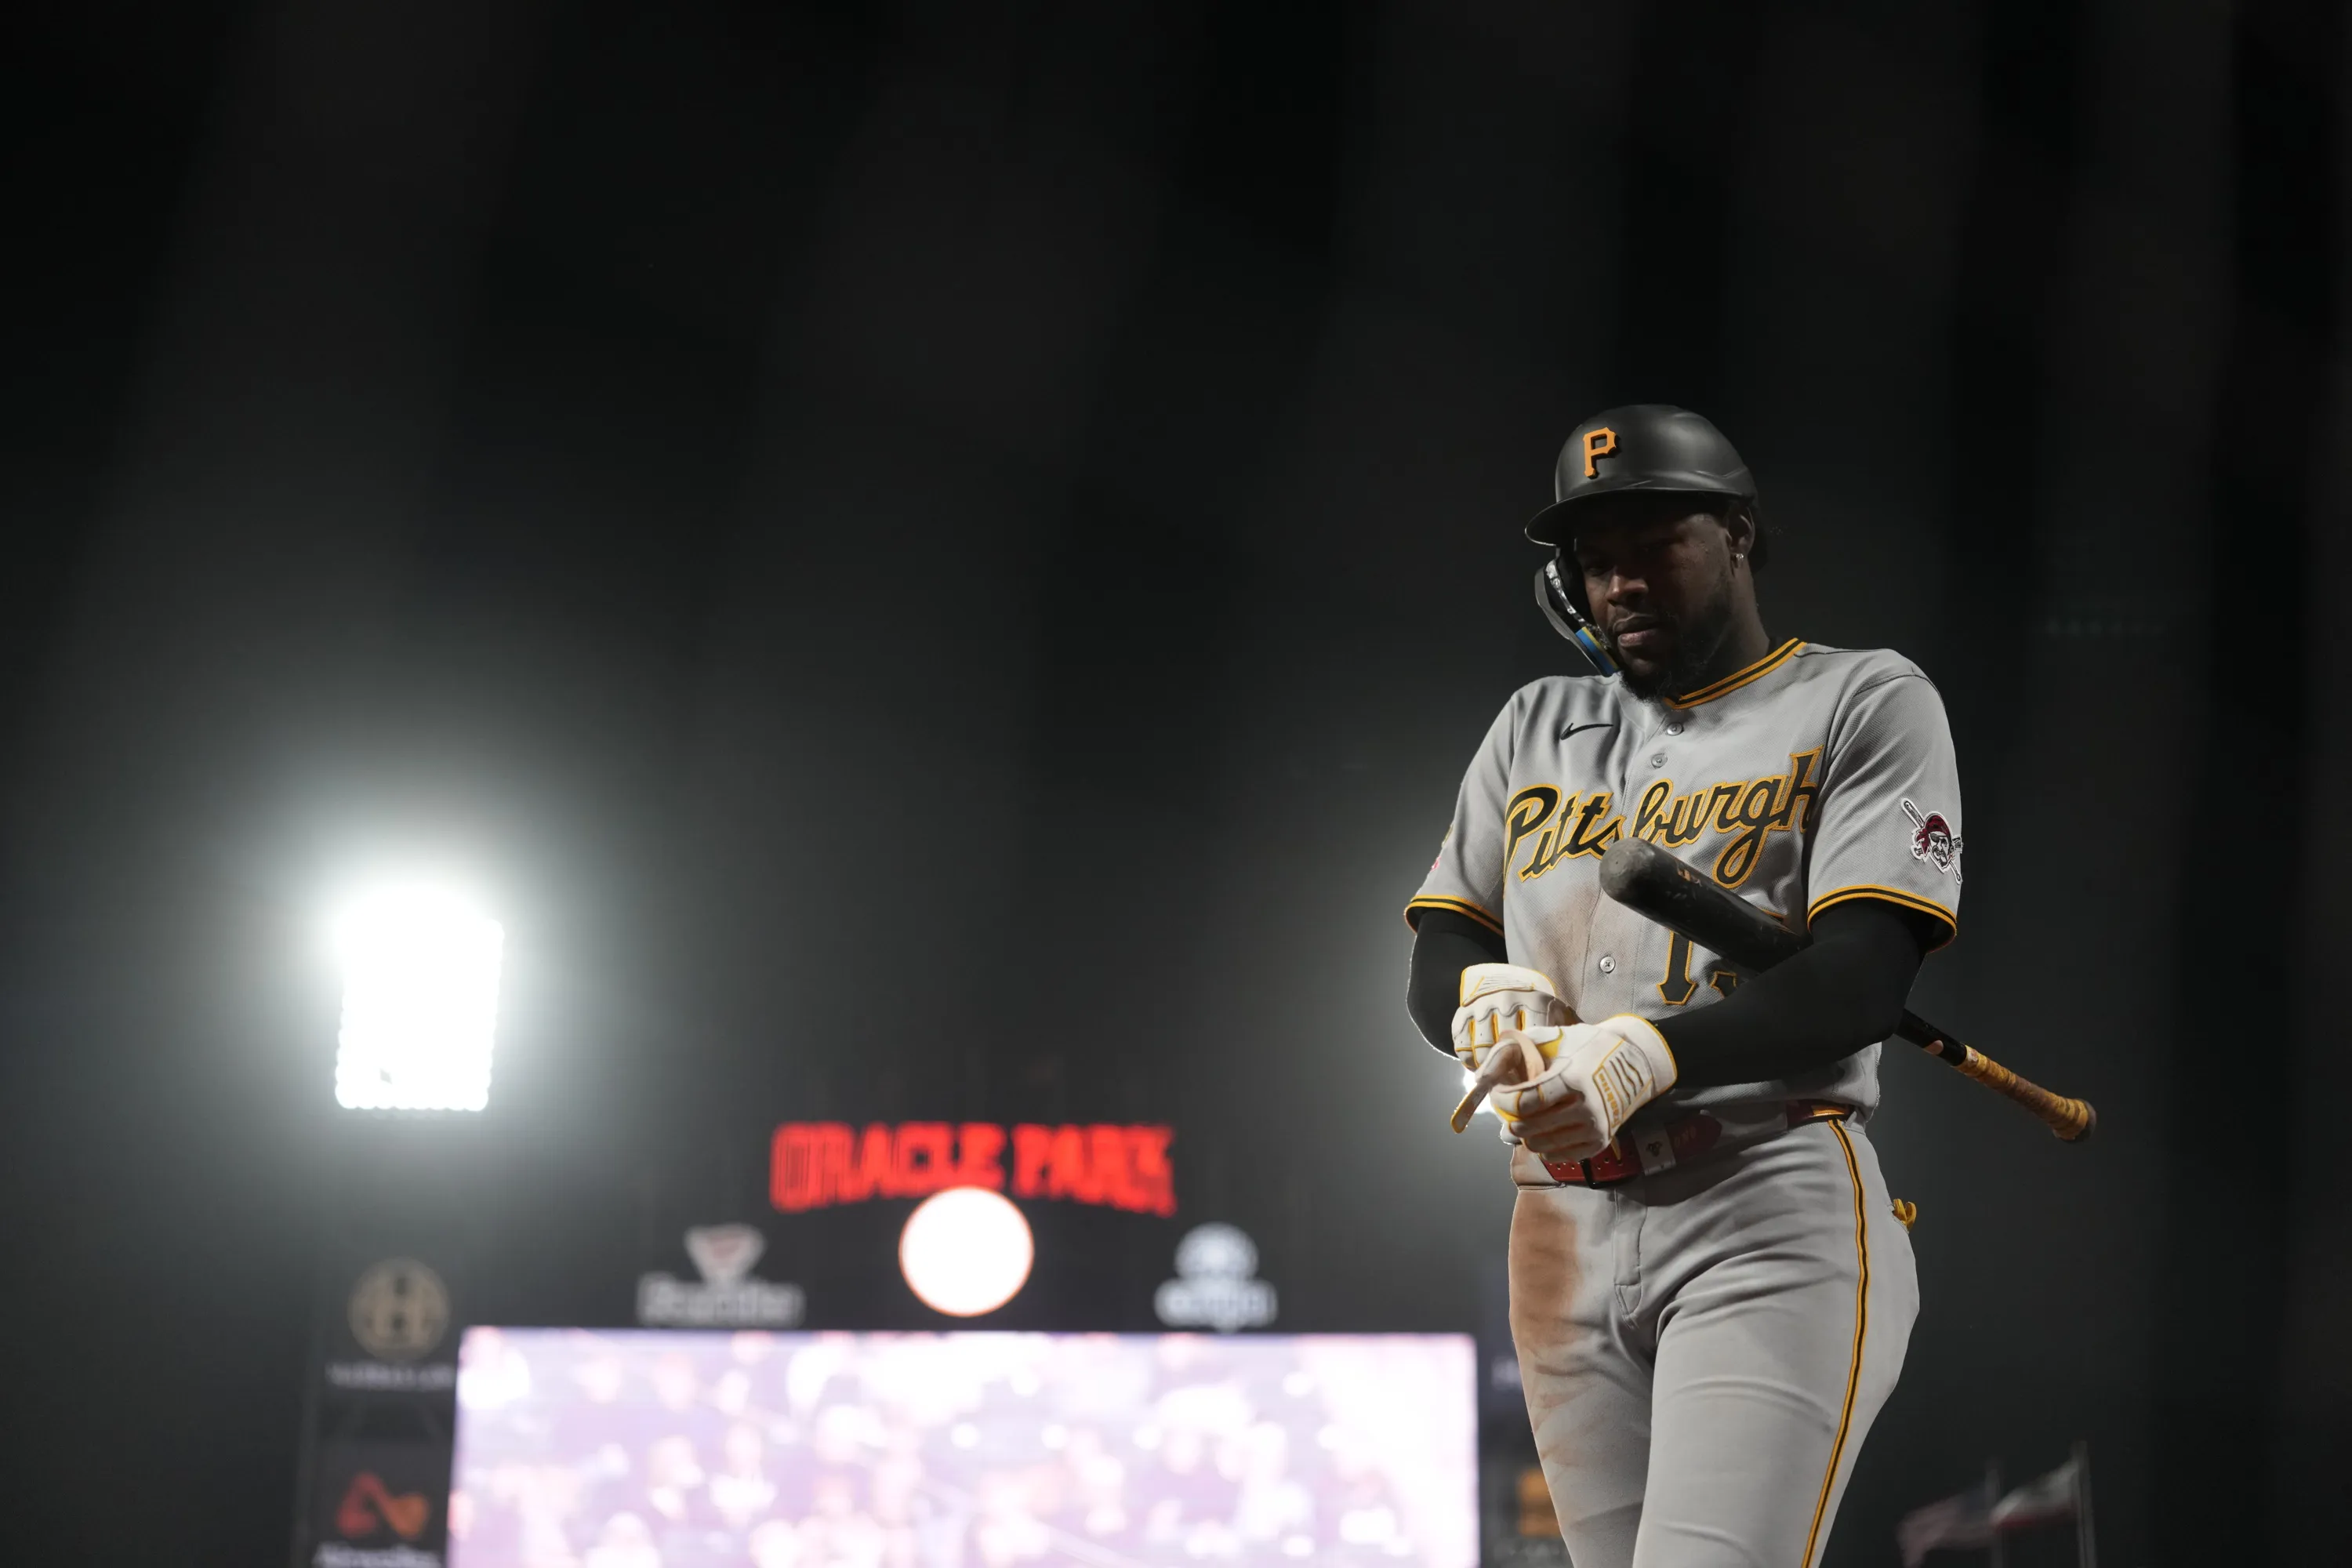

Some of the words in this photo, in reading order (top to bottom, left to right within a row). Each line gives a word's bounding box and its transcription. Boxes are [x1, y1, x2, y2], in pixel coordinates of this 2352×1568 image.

[1583, 427, 1617, 478] P
[1503, 745, 1824, 898] Pittsburgh
[1011, 1123, 1177, 1218] PARK
